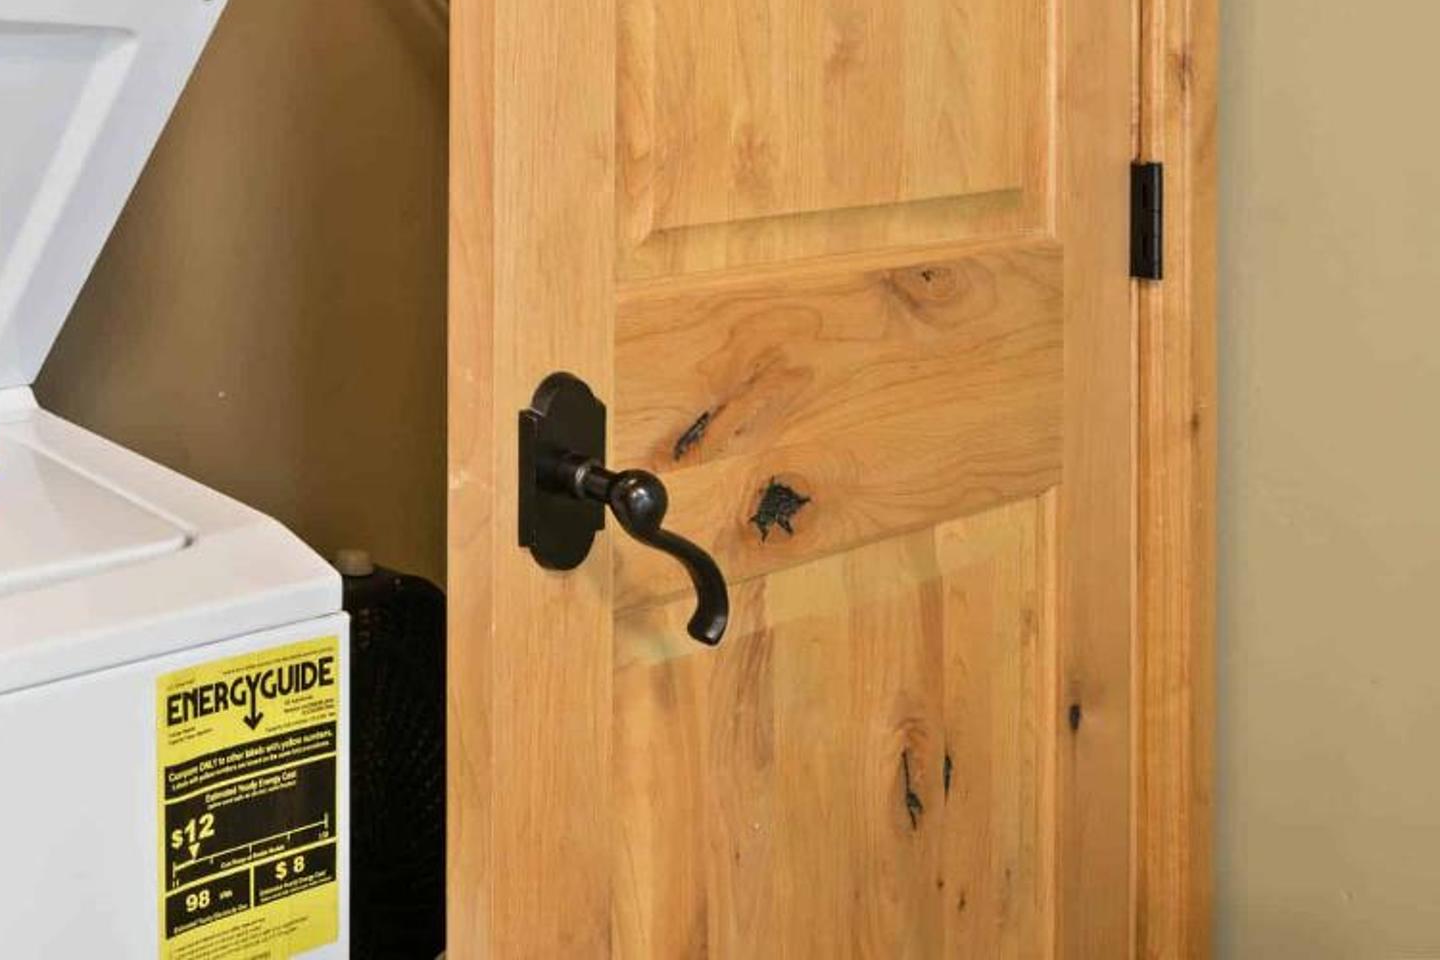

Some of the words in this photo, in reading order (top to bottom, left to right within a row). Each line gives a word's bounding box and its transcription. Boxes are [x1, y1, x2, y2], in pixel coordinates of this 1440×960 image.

[166, 656, 334, 727] ENERGYGUIDE
[171, 813, 215, 849] $12
[293, 856, 305, 874] 8
[185, 890, 211, 912] 98
